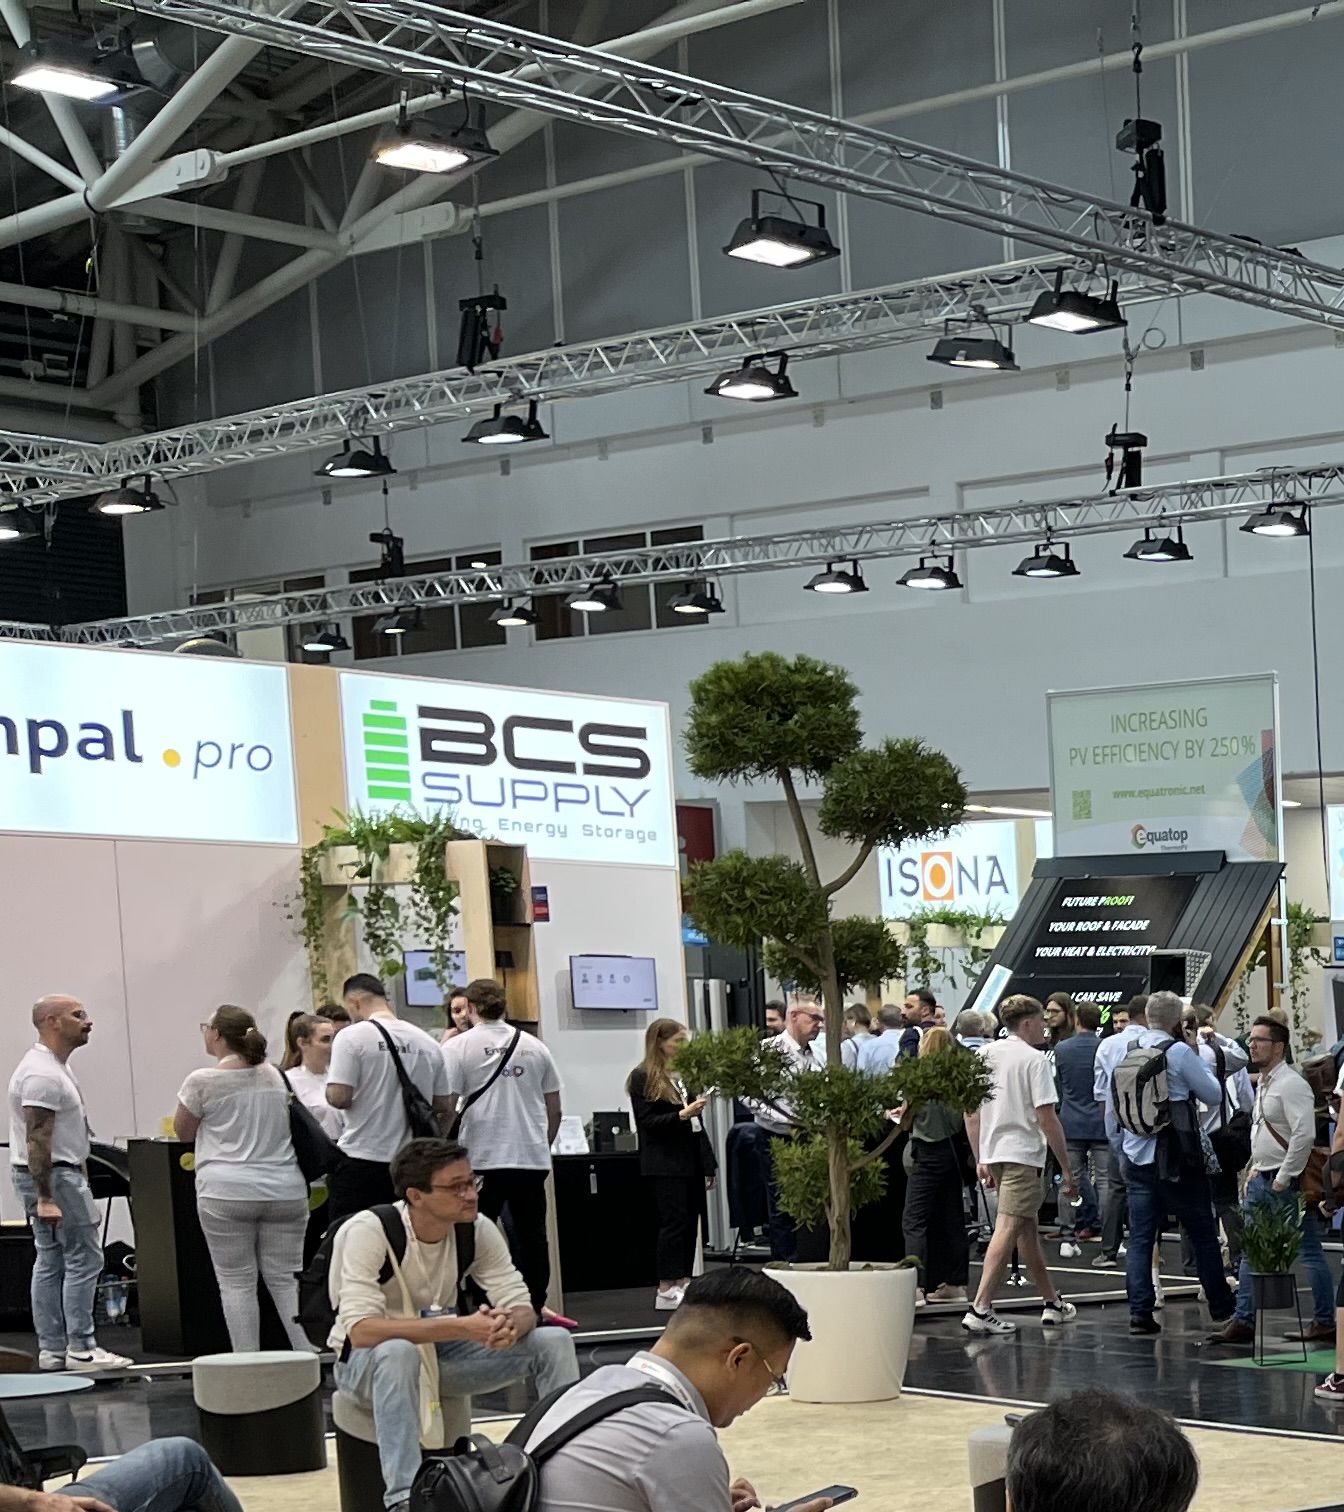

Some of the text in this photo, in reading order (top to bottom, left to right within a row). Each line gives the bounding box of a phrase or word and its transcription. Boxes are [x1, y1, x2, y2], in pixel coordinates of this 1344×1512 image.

[1110, 707, 1208, 734] INCREASING
[417, 704, 650, 780] BCS
[1069, 747, 1088, 767] PV
[1092, 740, 1180, 765] EFFICIENCY
[1185, 739, 1206, 760] BY
[421, 771, 651, 818] SUPPLY
[1112, 784, 1206, 800] www.equatronic.net
[498, 818, 568, 838] Energy
[582, 823, 657, 844] Storage
[886, 854, 1009, 898] ISONA
[1061, 896, 1098, 907] FUTURE
[1048, 921, 1075, 933] YOUR
[1110, 919, 1151, 932] FACADE
[1035, 946, 1060, 958] YOUR
[1060, 946, 1087, 957] HEAT
[1074, 992, 1097, 1002] CAN
[1096, 991, 1122, 1002] SAVE
